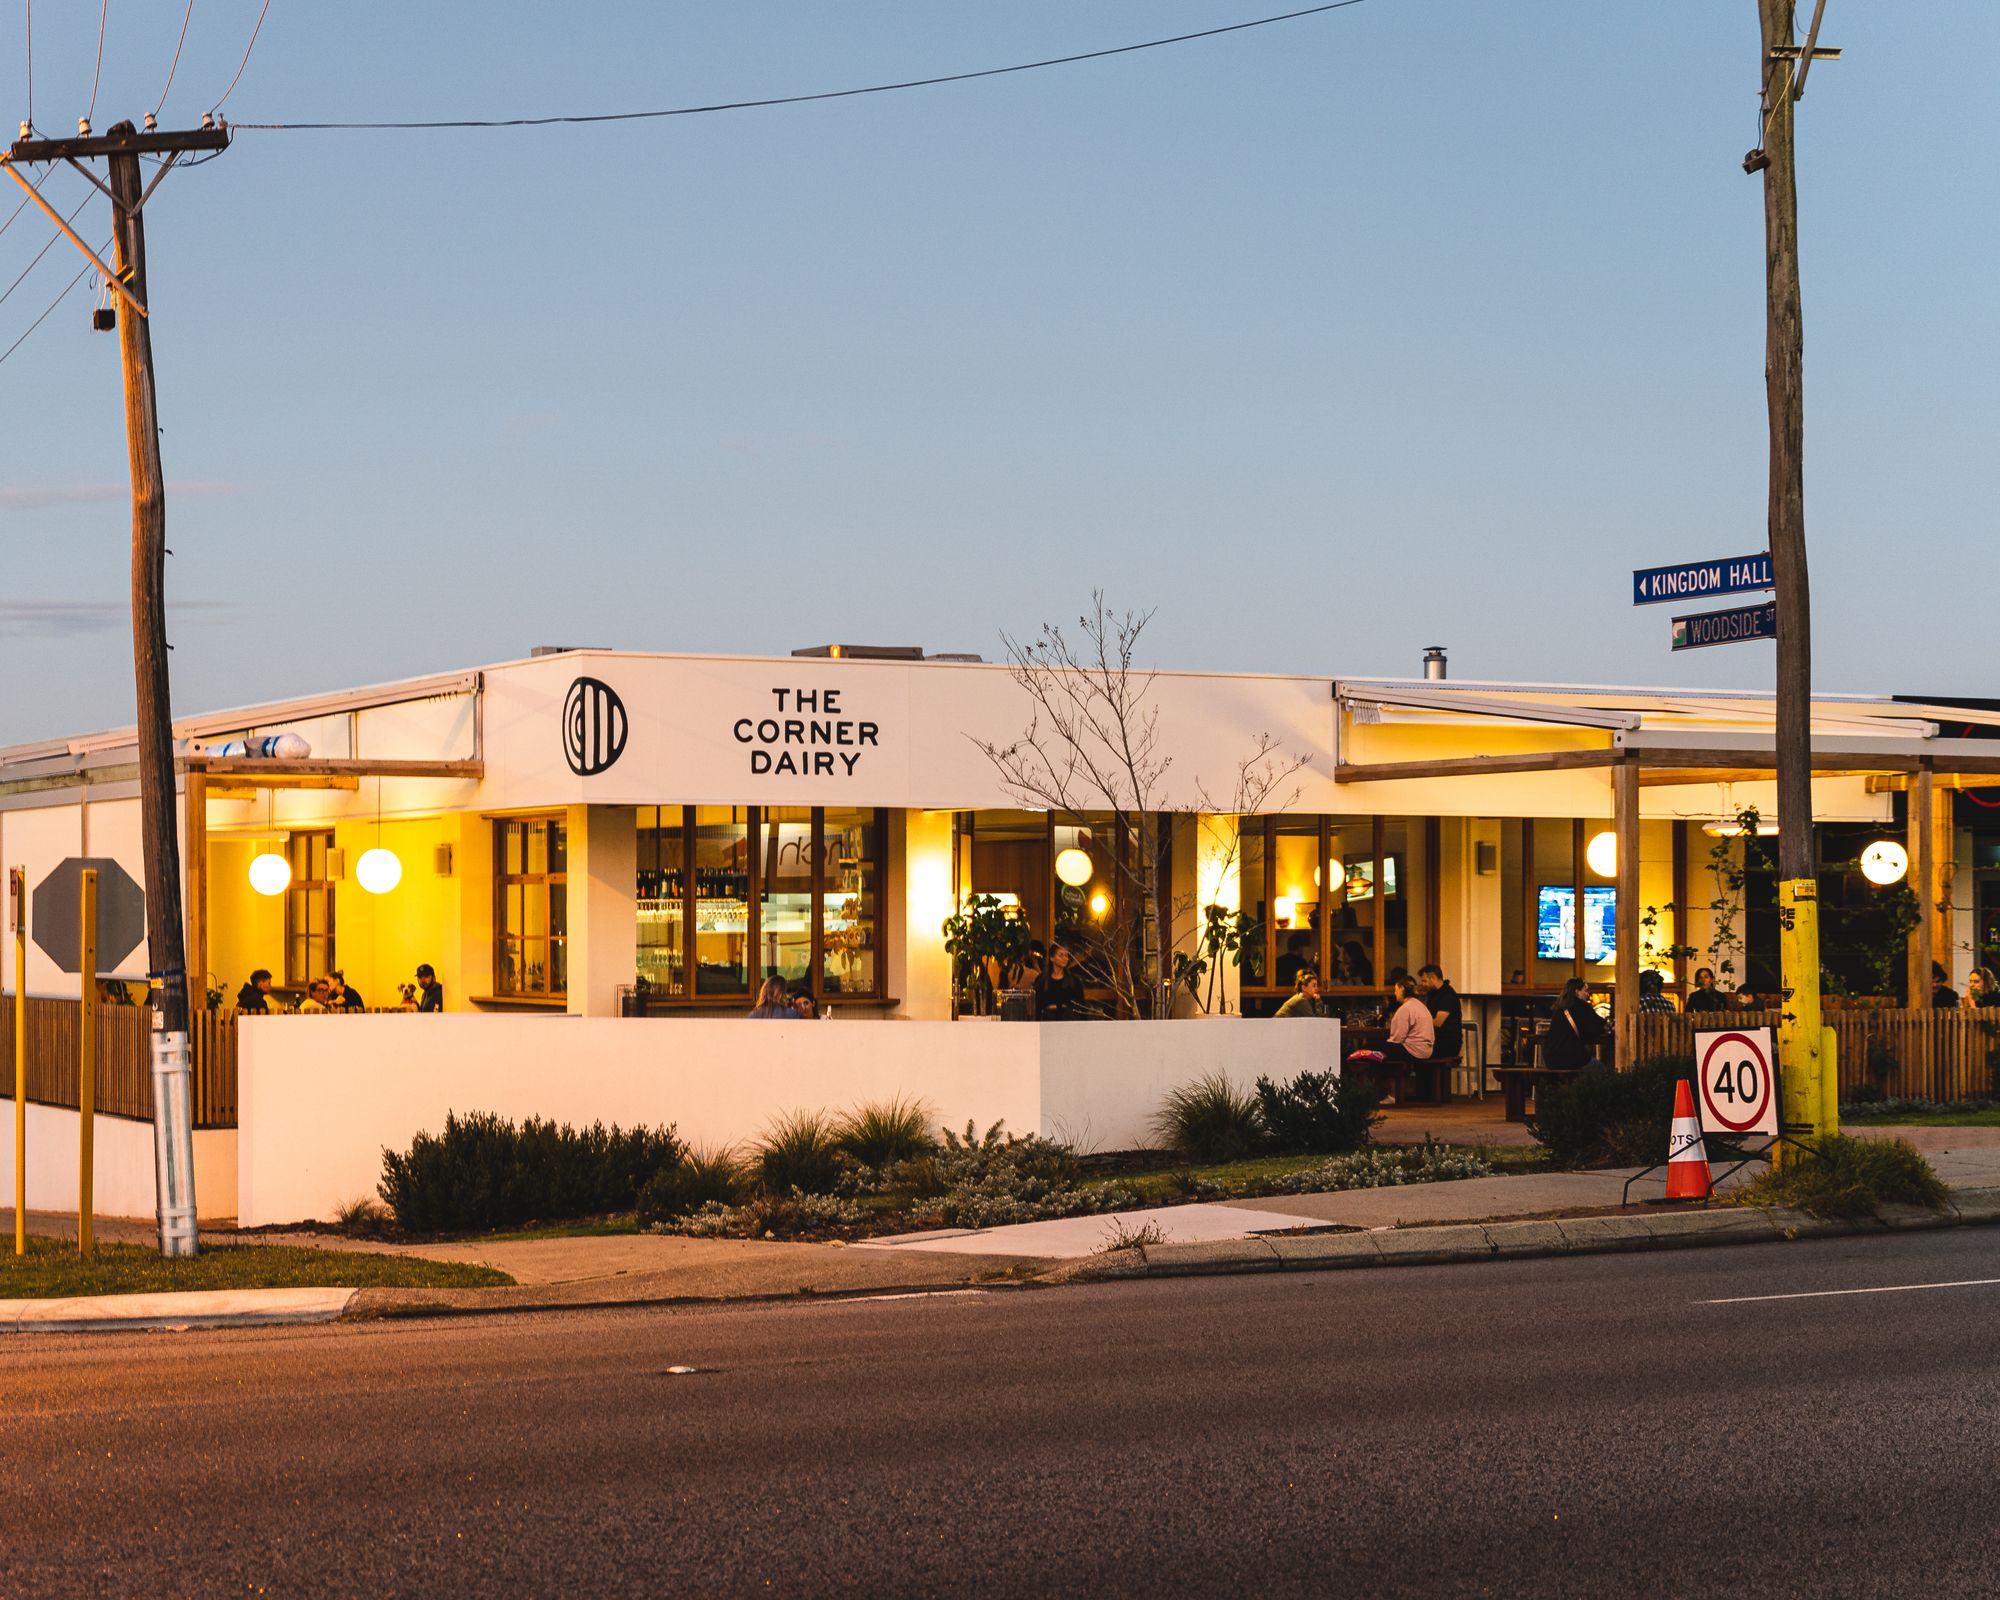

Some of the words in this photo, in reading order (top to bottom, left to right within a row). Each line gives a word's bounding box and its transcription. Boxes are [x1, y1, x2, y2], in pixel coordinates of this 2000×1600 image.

[1652, 567, 1721, 596] KINGDOM
[1730, 561, 1772, 587] HALL
[1691, 611, 1762, 642] WOODSIDE
[1766, 608, 1775, 622] ST
[772, 688, 841, 714] THE
[733, 718, 879, 746] CORNER
[751, 750, 861, 776] DAIRY
[1713, 1060, 1758, 1104] 40
